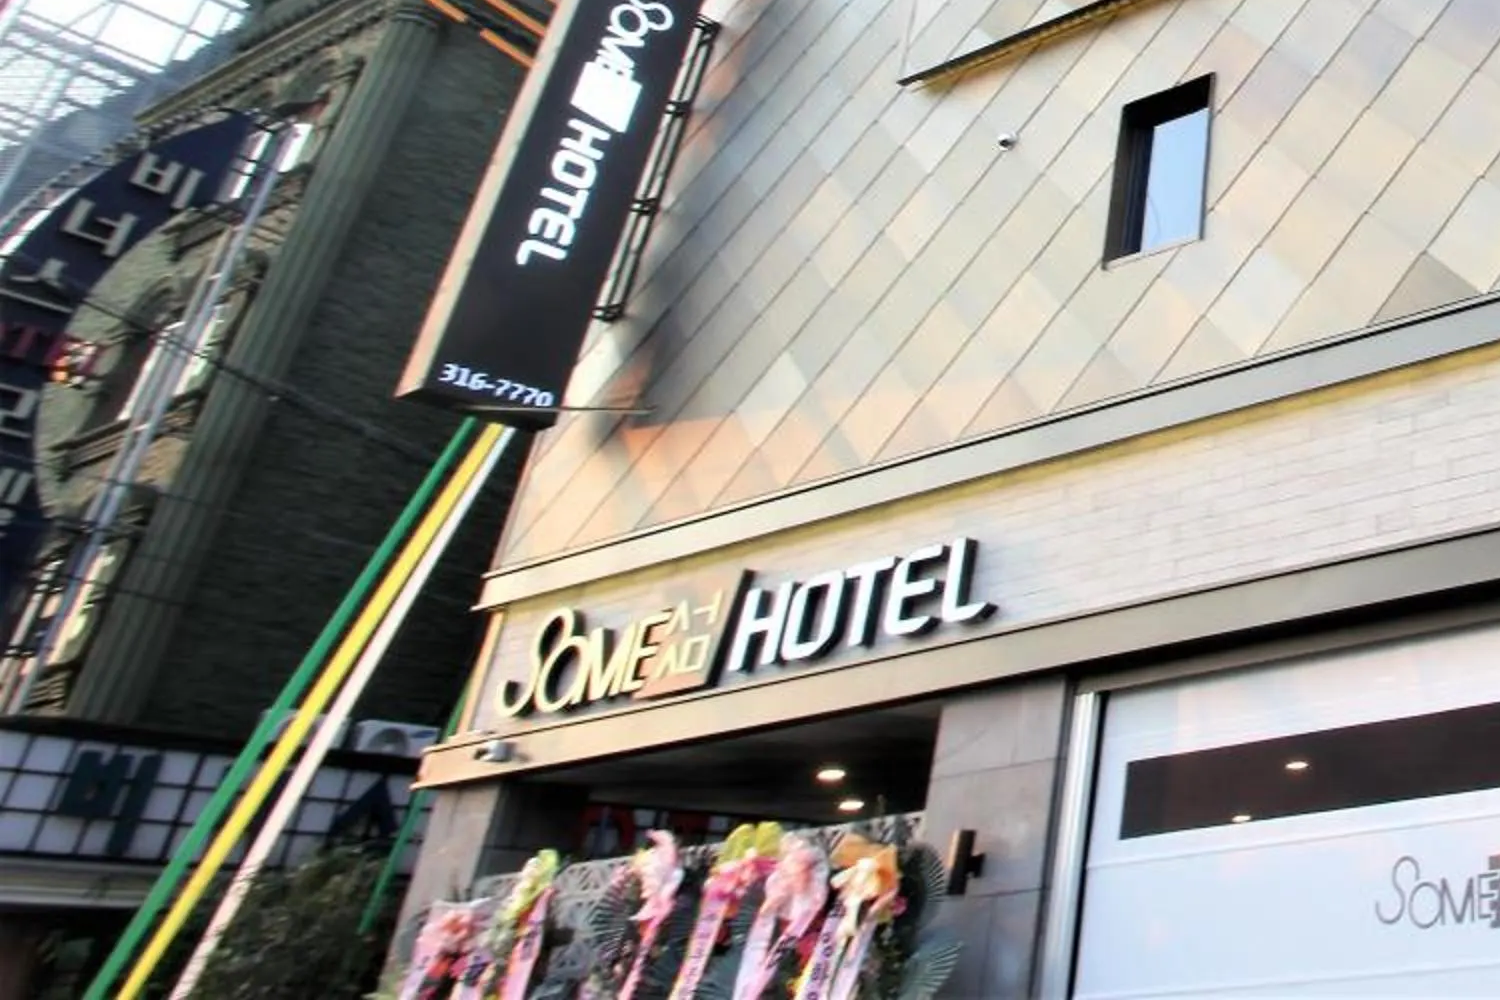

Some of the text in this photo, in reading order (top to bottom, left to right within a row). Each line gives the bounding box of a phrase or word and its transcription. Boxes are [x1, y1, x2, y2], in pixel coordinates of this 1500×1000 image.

[516, 117, 612, 267] HOTEL
[438, 363, 555, 407] 316-7770
[728, 537, 994, 672] HOTEL
